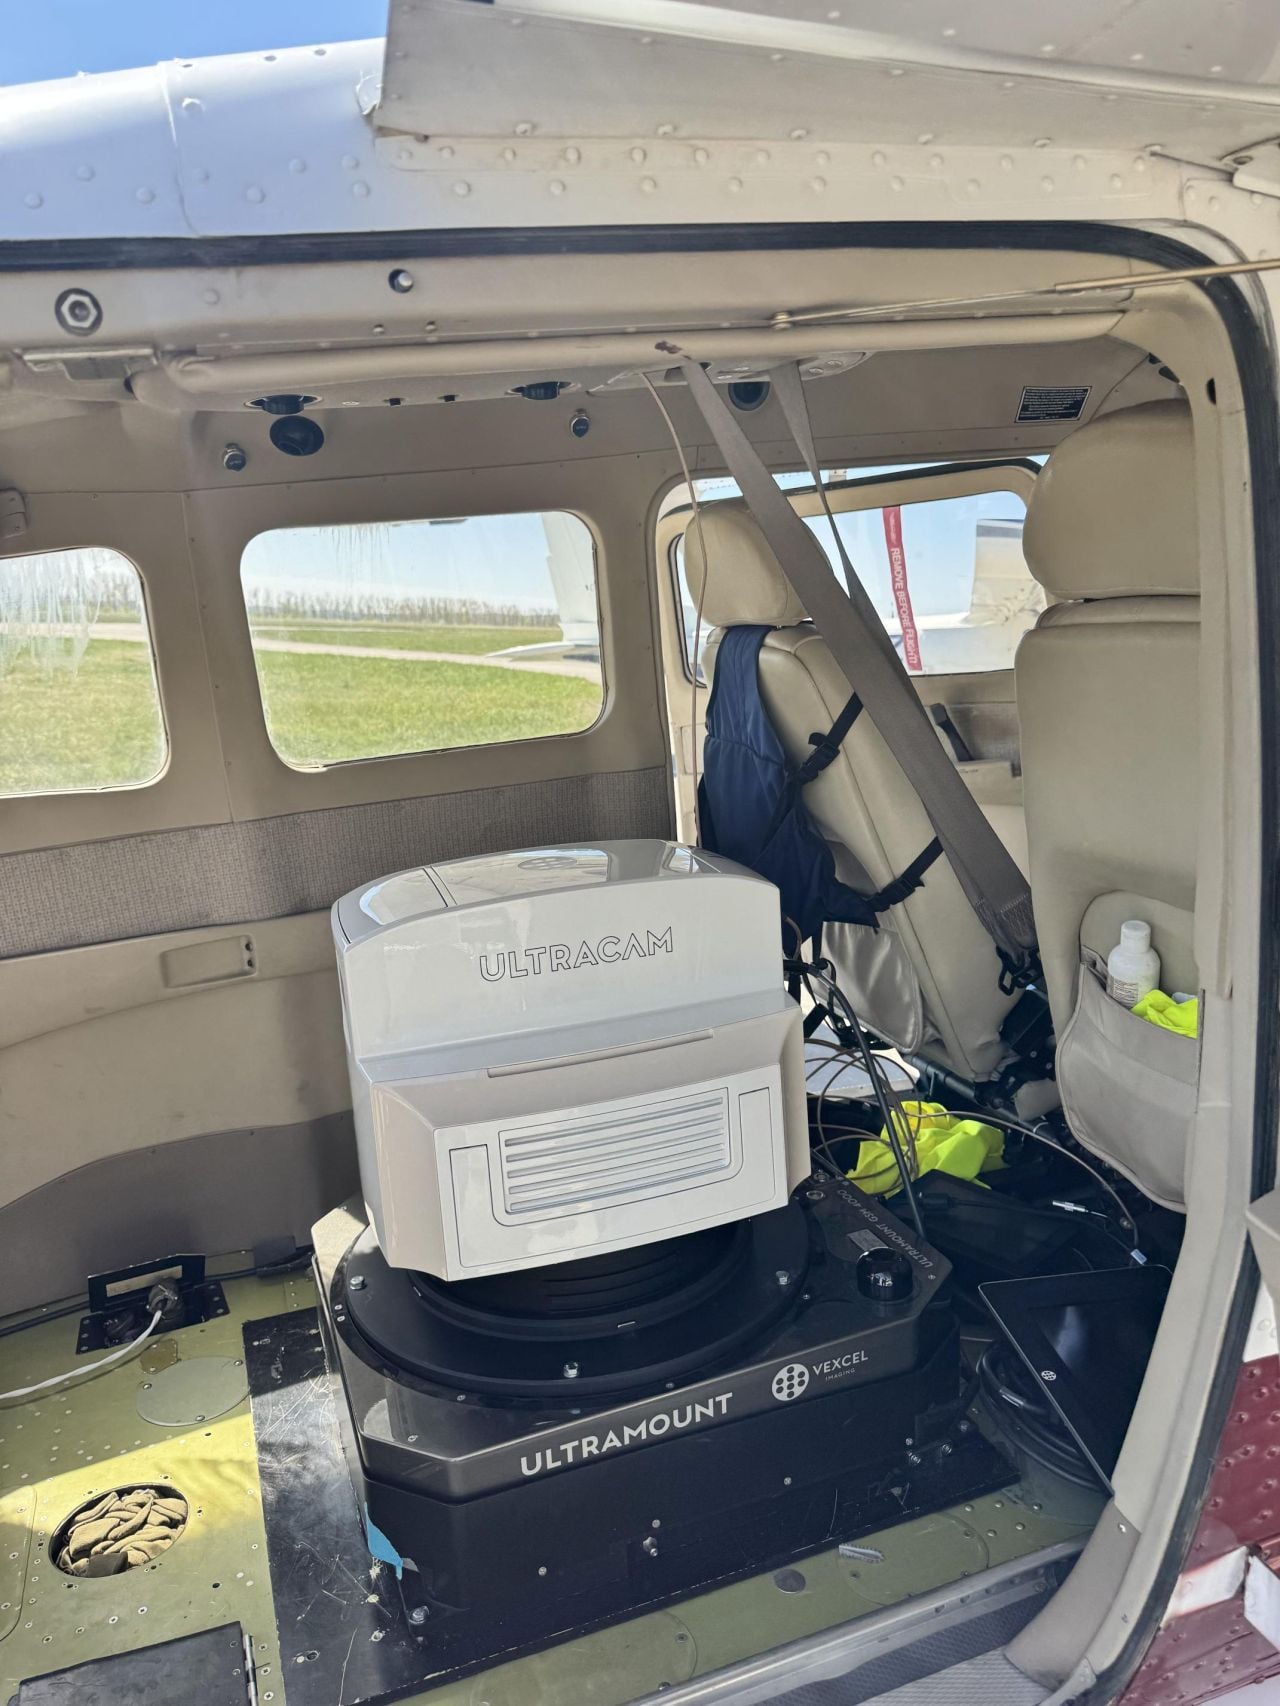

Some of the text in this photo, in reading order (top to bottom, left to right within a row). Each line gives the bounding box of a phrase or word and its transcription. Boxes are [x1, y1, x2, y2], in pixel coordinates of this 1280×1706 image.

[890, 547, 904, 590] REMOVE
[896, 590, 912, 628] BEFORE
[479, 926, 674, 982] ULTRACAM
[837, 1189, 862, 1209] 4000
[875, 1223, 934, 1268] ULTRAMOUNT
[812, 1350, 869, 1377] VEXCEL
[824, 1367, 856, 1382] IMAGING
[520, 1392, 734, 1477] ULTRAMOUNT
